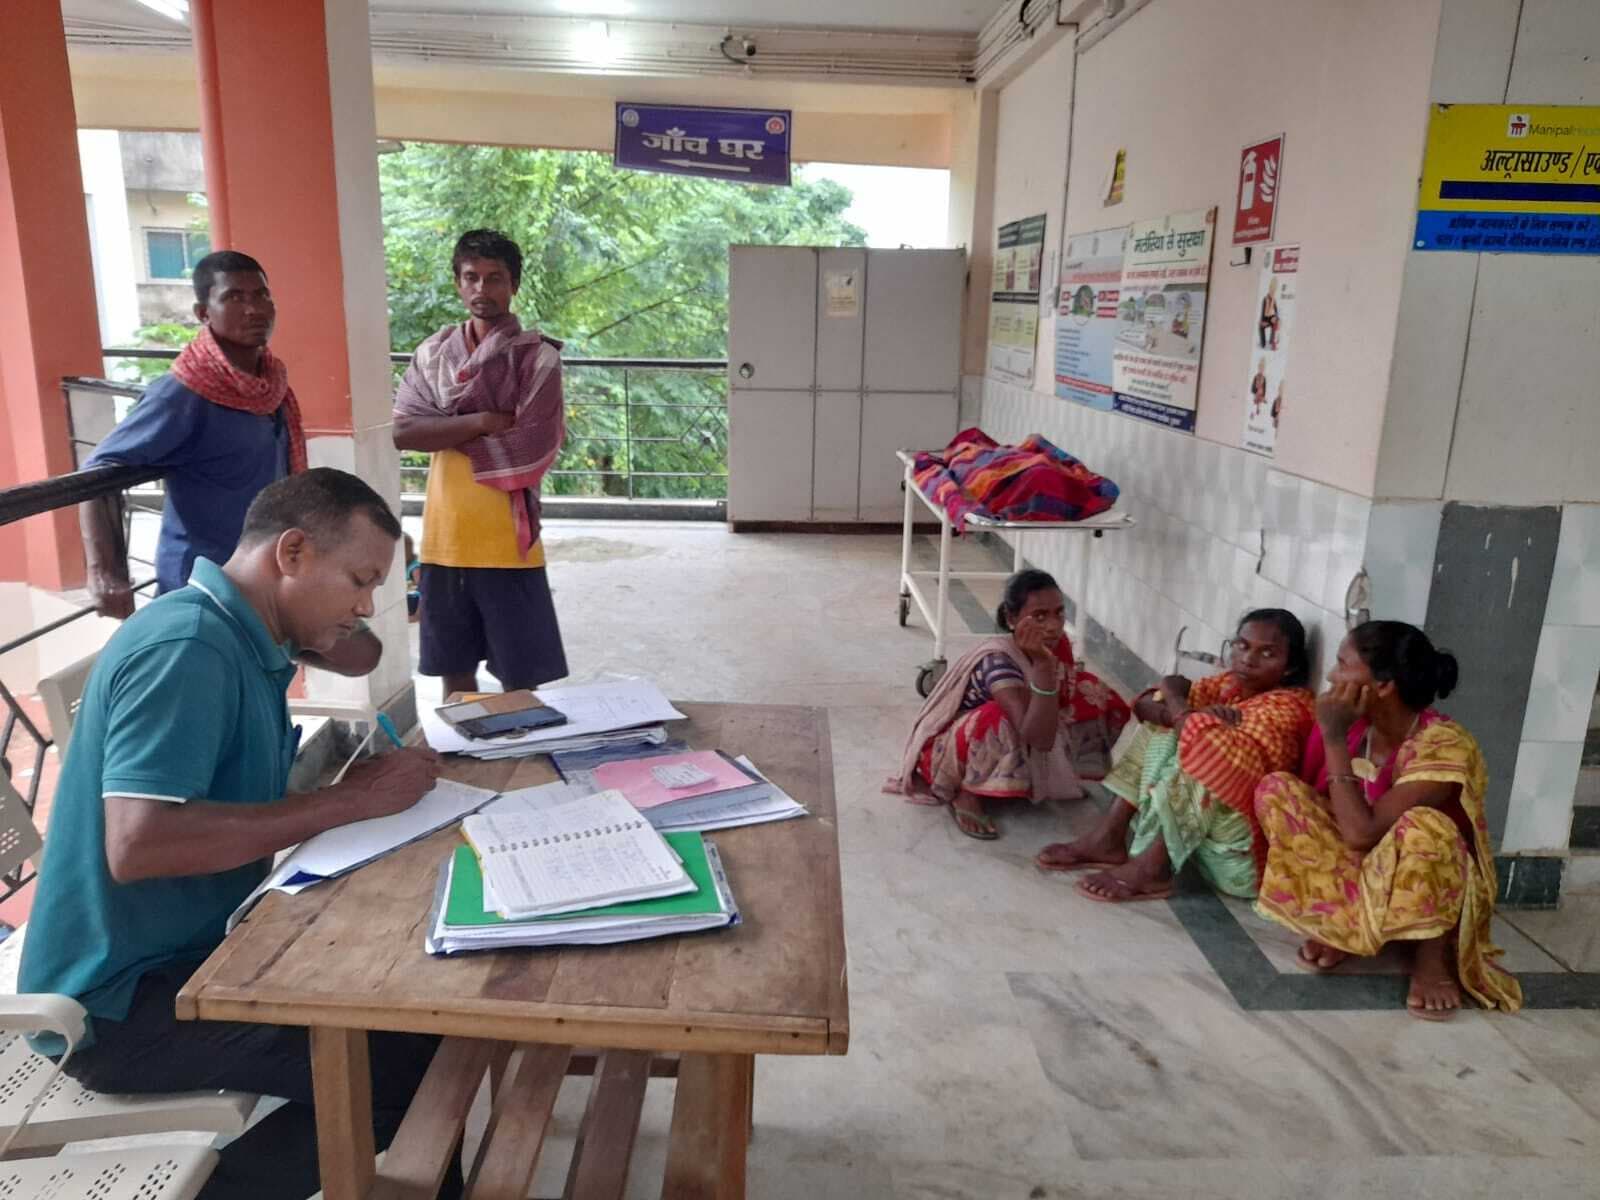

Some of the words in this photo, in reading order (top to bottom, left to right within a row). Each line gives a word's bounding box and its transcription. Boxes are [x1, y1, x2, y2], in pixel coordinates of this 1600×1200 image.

[641, 127, 709, 155] जाँच
[718, 139, 766, 160] घर
[1166, 228, 1175, 250] से
